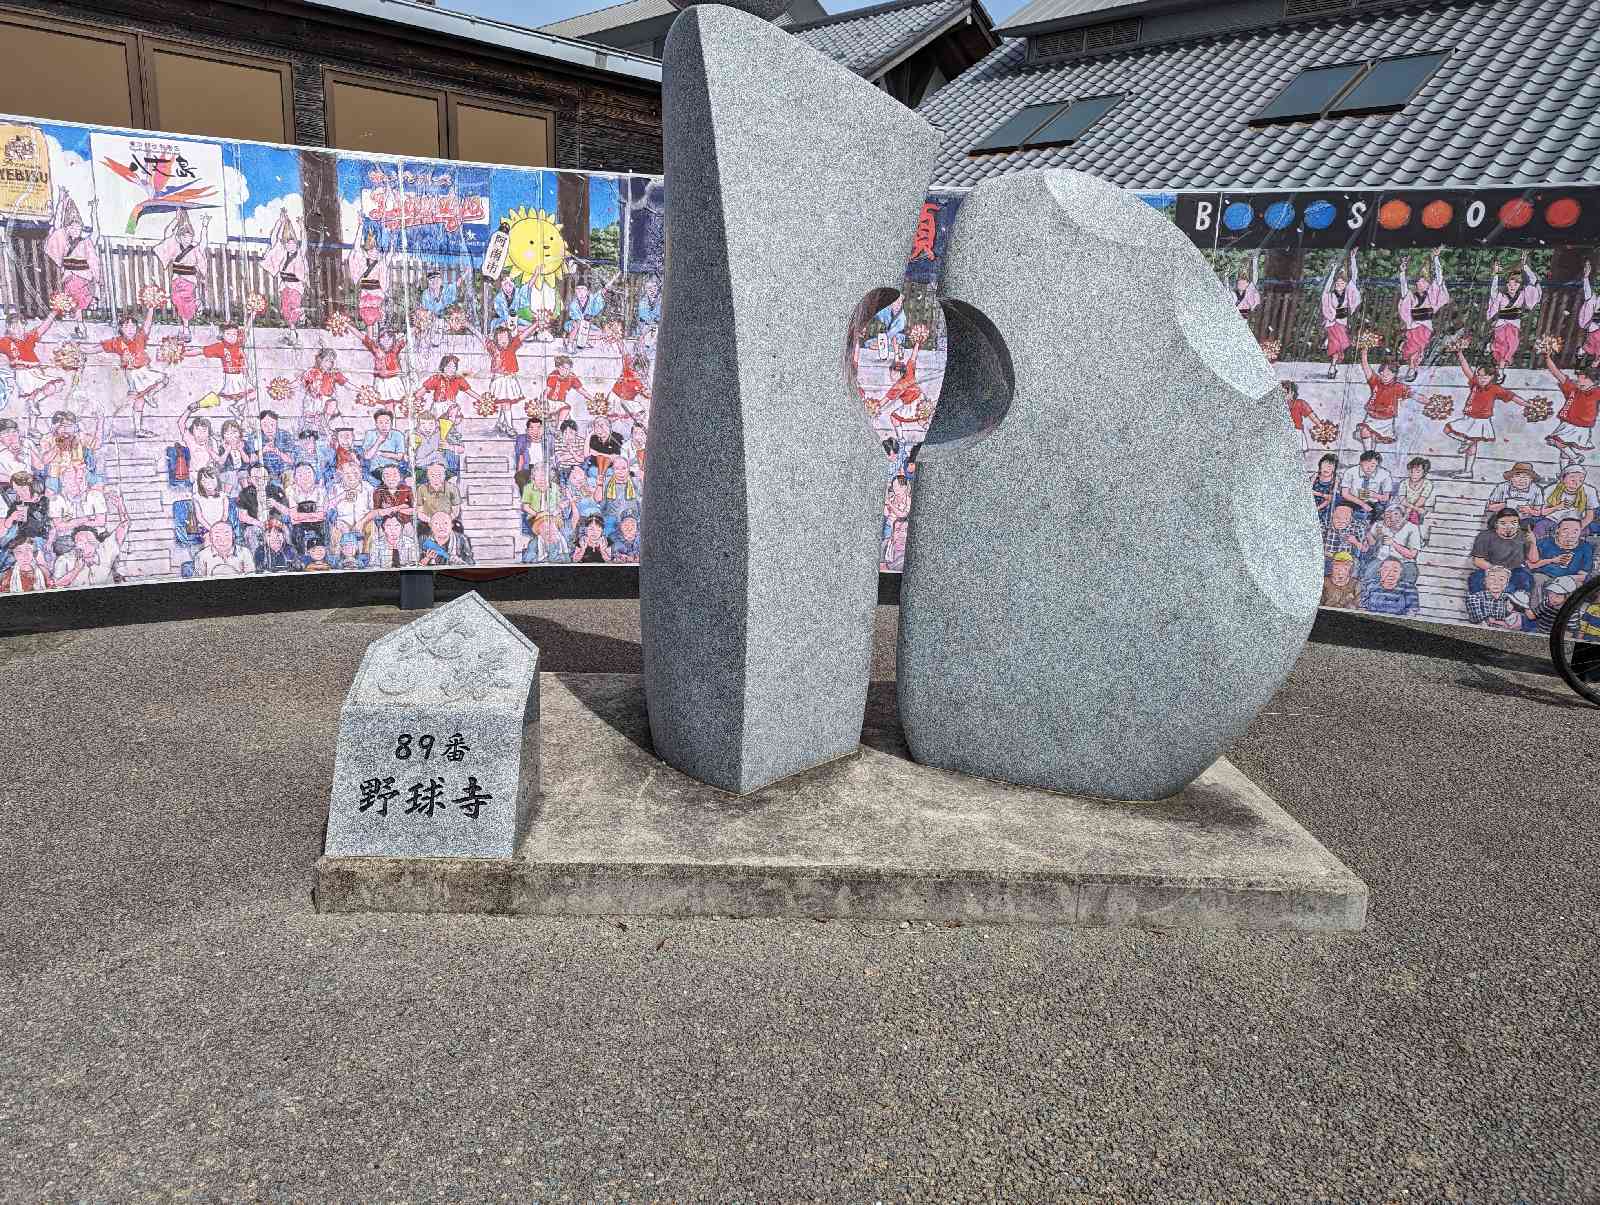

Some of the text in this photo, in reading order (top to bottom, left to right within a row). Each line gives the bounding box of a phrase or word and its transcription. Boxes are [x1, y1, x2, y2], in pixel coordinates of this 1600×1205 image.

[1195, 200, 1486, 231] B S O
[395, 733, 470, 762] 89番
[358, 776, 494, 820] 野球寺
